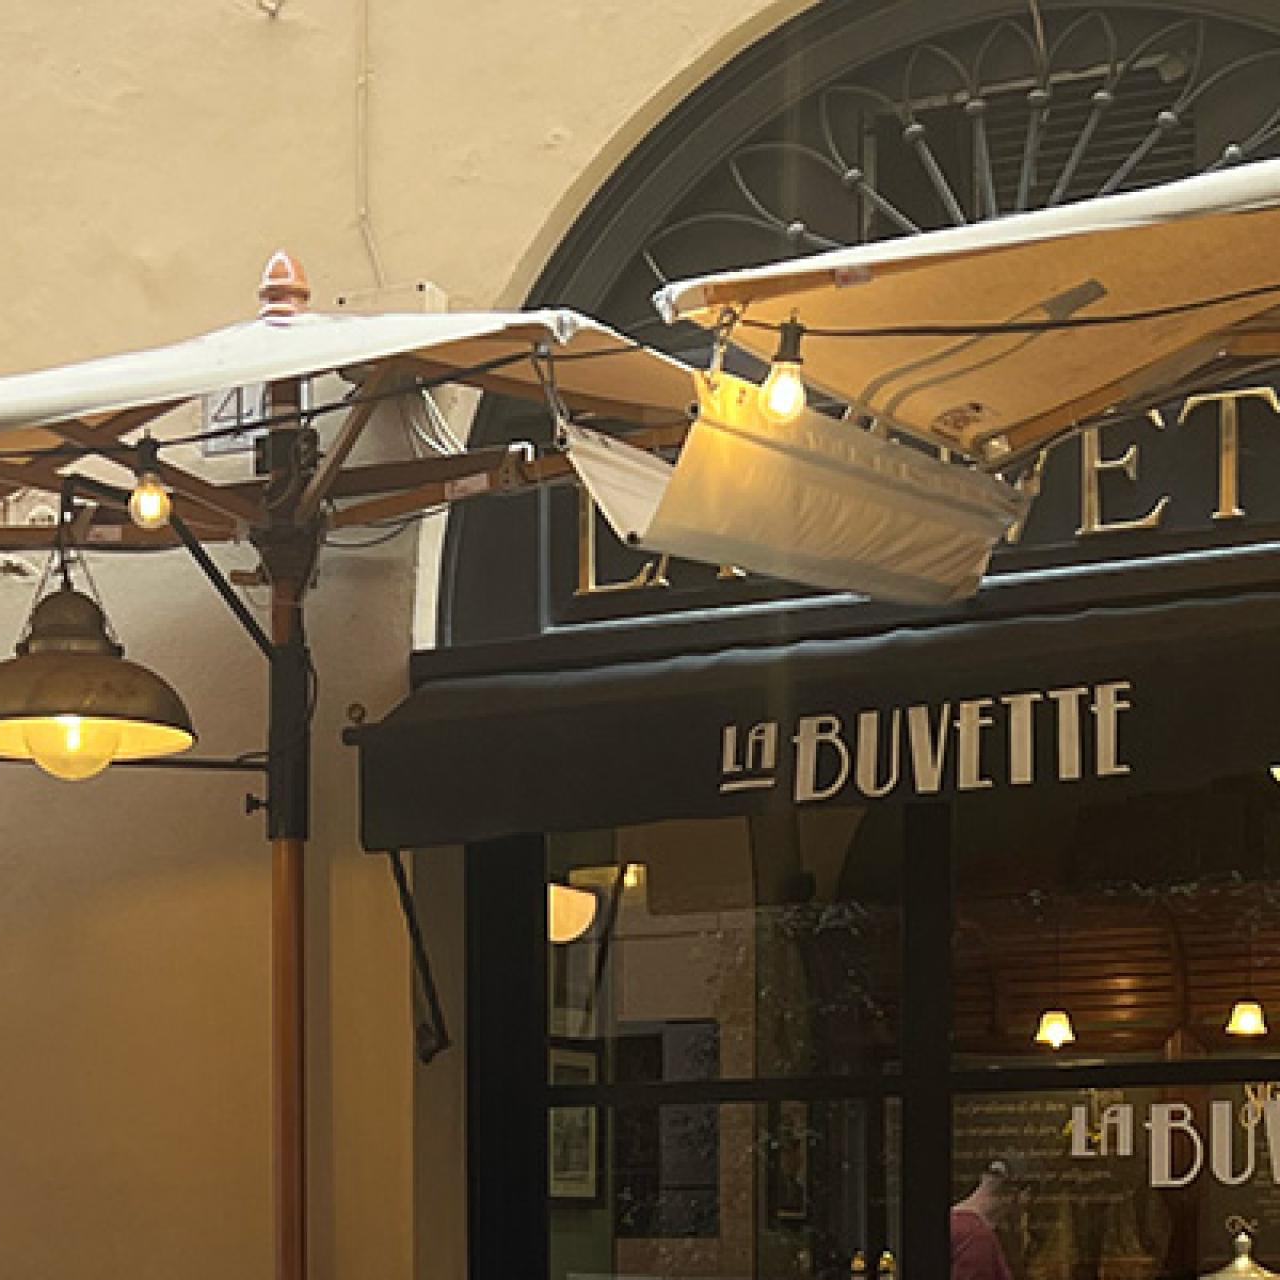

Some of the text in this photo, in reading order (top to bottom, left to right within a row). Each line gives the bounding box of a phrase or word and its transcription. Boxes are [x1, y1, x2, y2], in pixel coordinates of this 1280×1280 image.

[720, 681, 1131, 803] LA BUVETTE
[1072, 1103, 1134, 1156] LA
